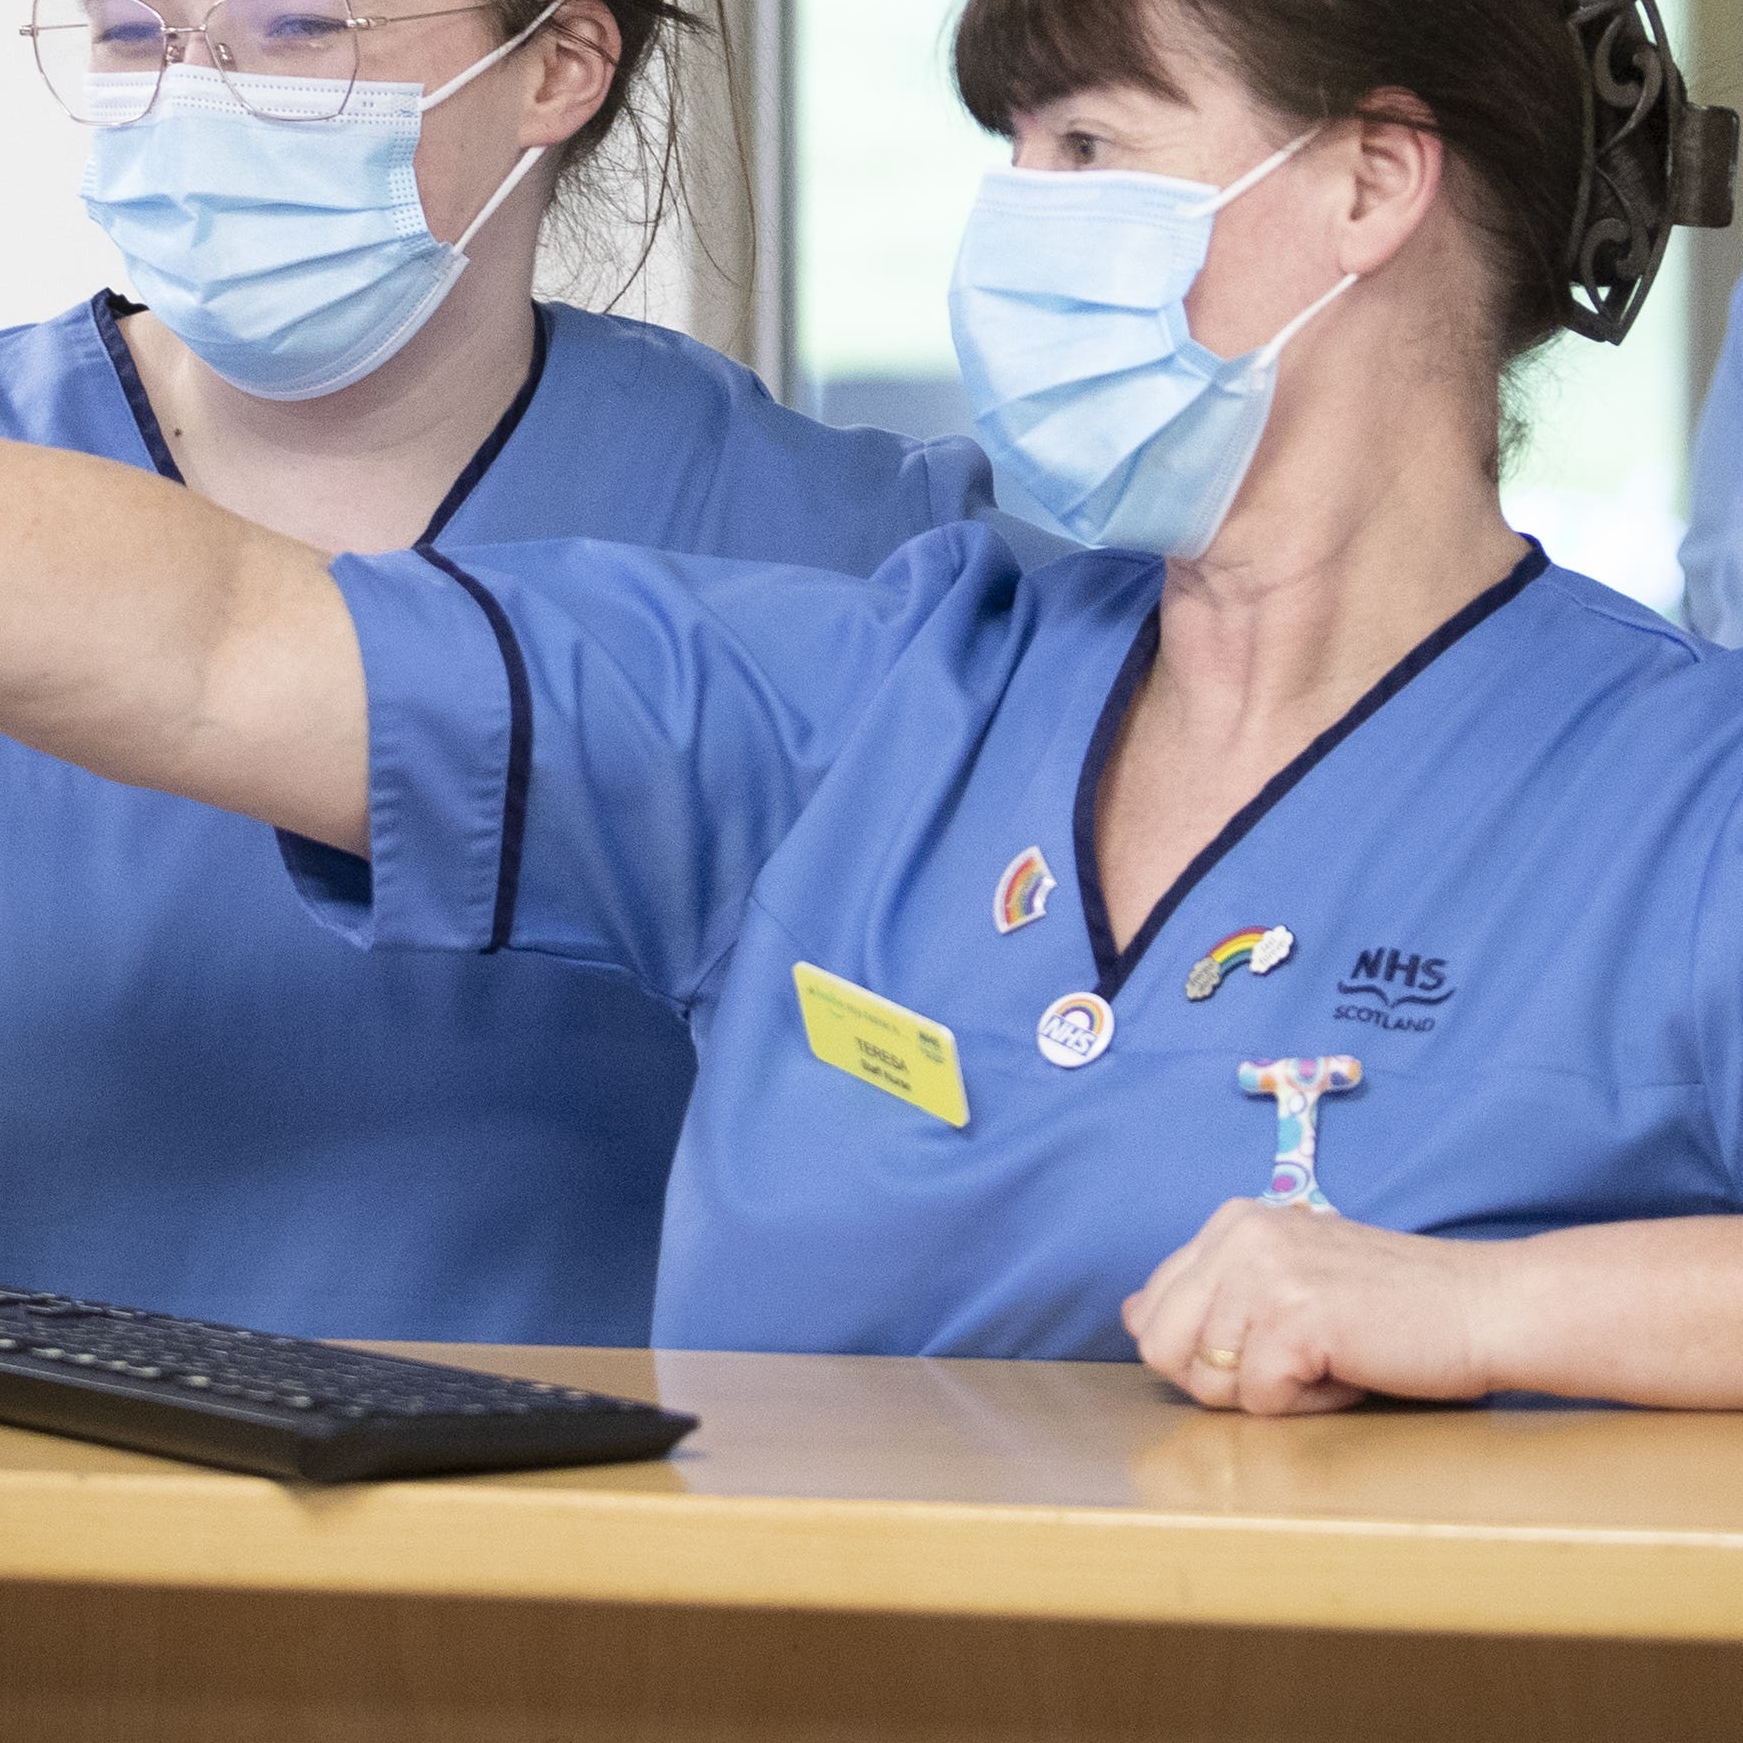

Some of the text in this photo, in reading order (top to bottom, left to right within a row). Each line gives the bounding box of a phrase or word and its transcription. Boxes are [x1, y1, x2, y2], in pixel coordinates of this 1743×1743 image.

[1351, 948, 1446, 991] NHS
[1041, 1015, 1097, 1055] NHS
[1333, 1006, 1436, 1032] SCOTLAND
[855, 1036, 911, 1075] TERESA
